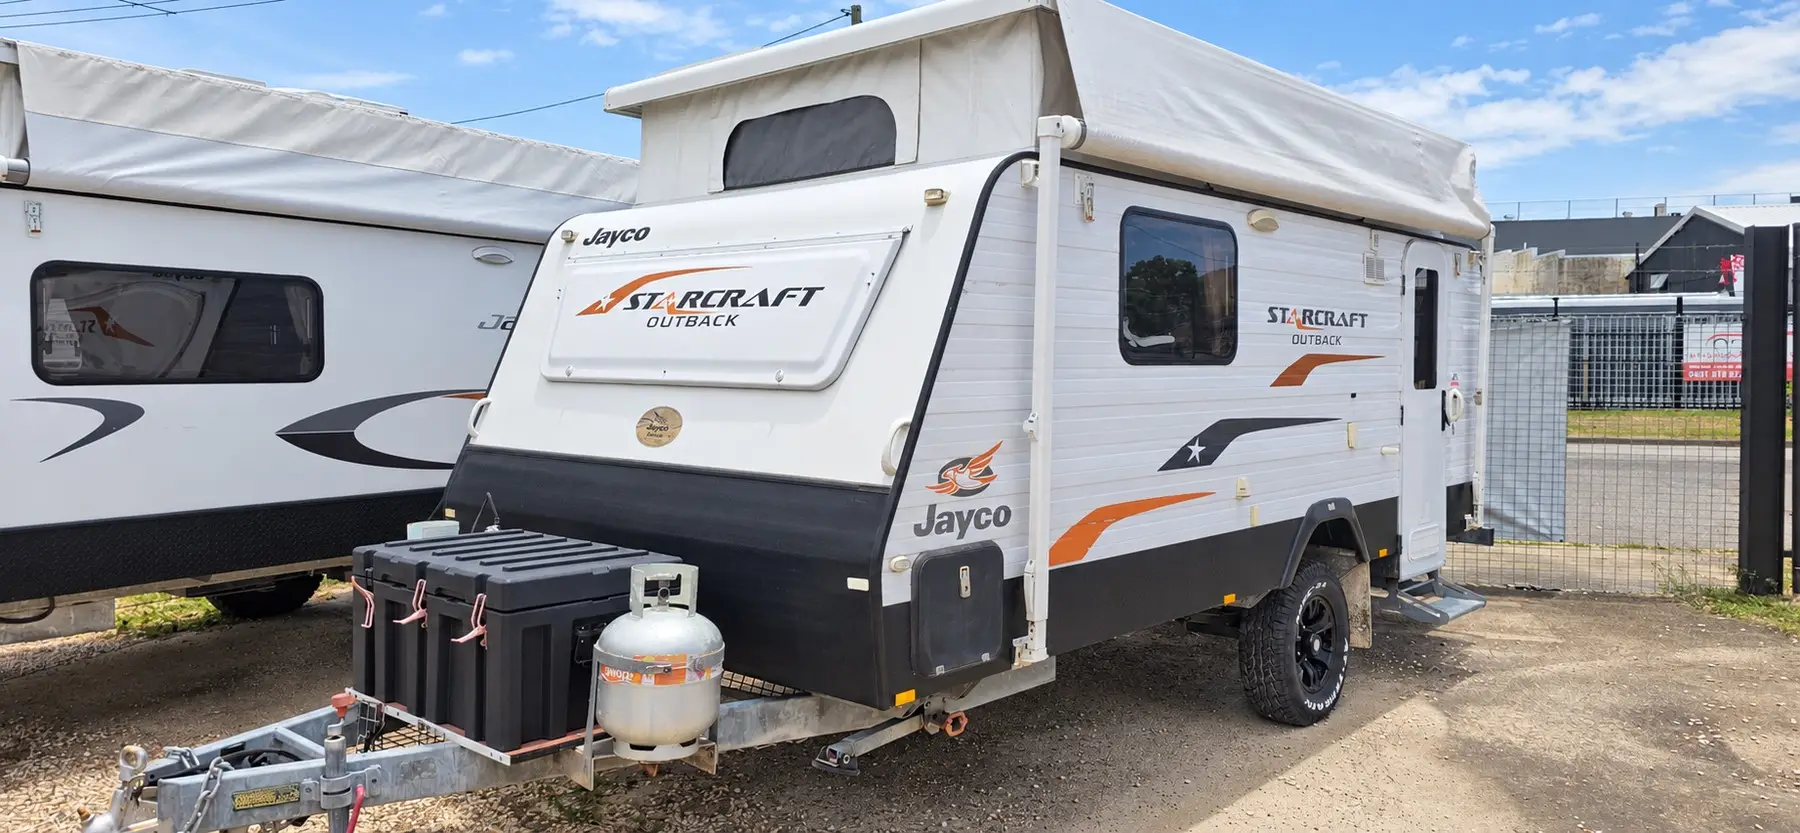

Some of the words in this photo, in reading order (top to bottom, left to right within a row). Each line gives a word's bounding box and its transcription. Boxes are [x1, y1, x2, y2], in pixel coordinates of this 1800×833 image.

[582, 226, 651, 249] Jayco
[622, 286, 825, 312] STARCRAFT
[646, 314, 740, 328] OUTBACK
[1266, 306, 1369, 329] STARCRAFT
[1291, 334, 1342, 346] OUTBACK
[913, 503, 1012, 540] Jayco
